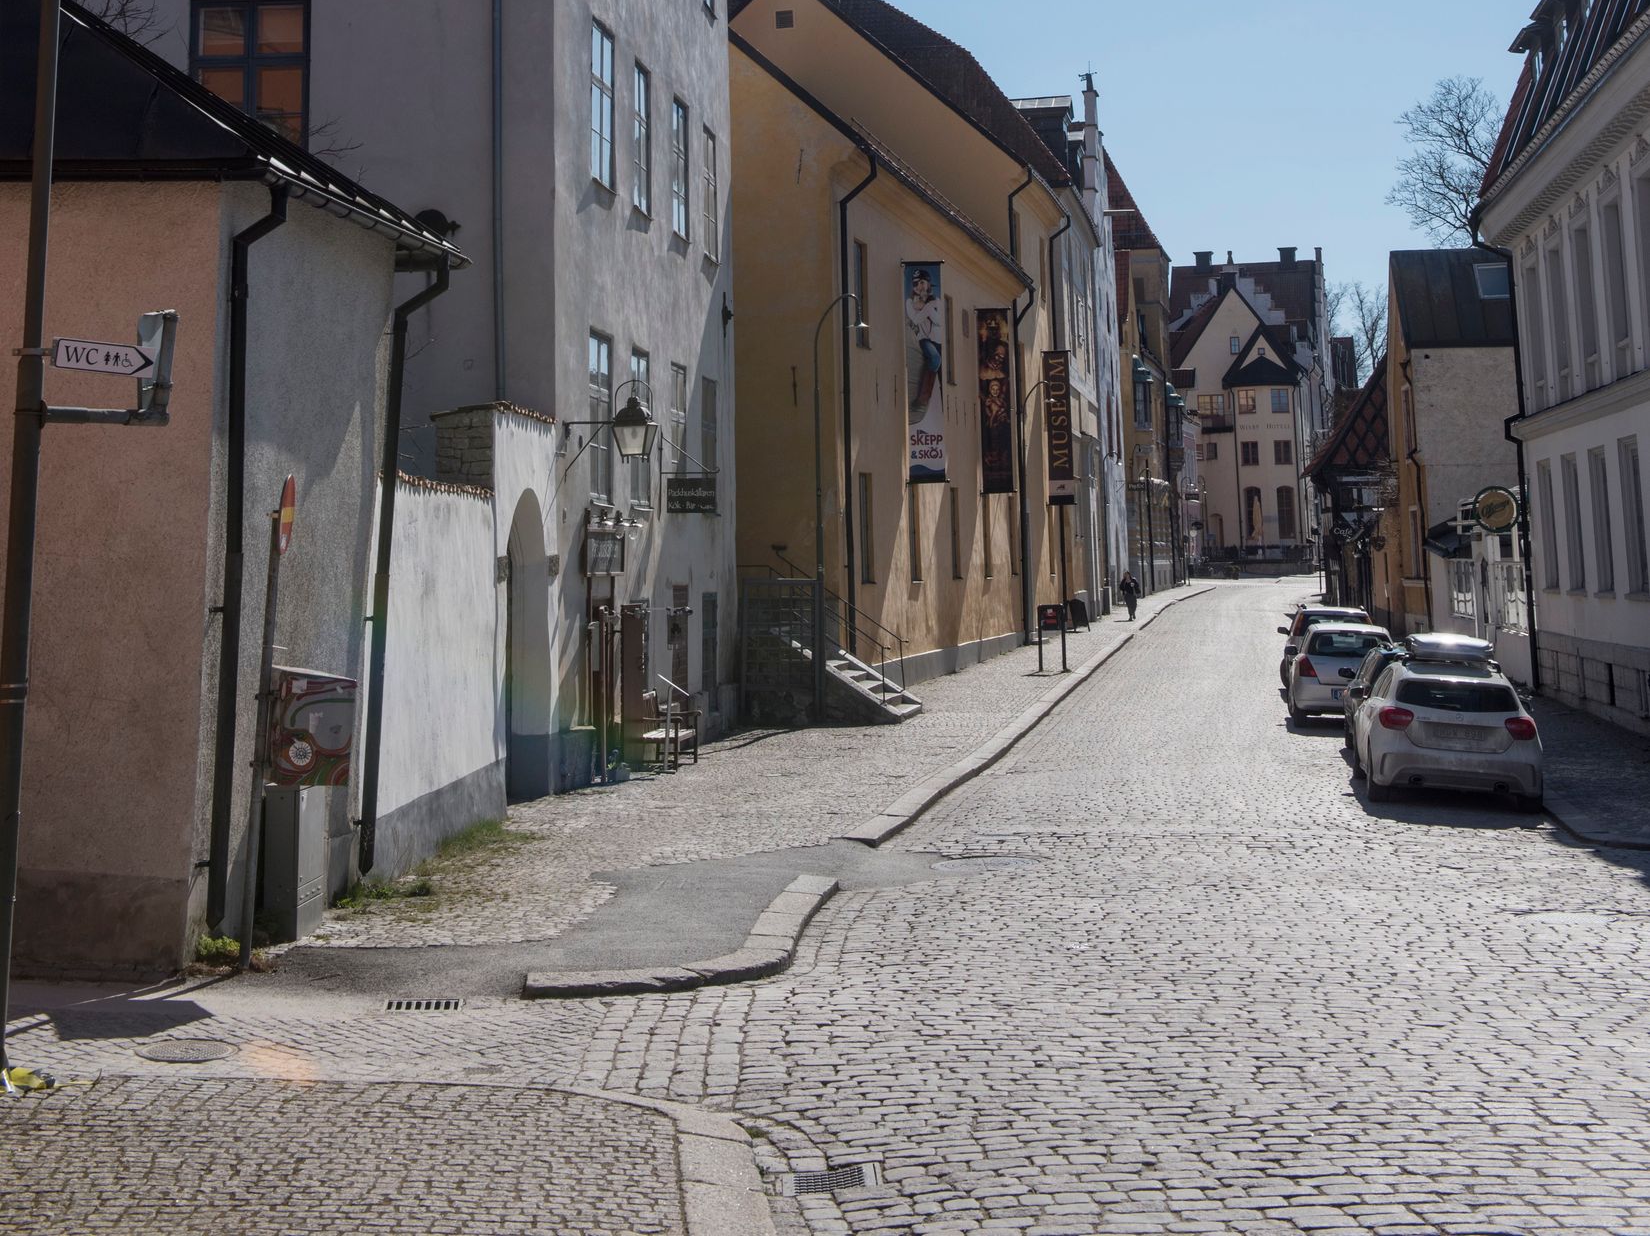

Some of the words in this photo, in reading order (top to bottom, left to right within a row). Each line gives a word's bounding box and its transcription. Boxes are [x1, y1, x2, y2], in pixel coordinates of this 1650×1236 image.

[65, 345, 99, 366] WC
[1049, 357, 1069, 468] MUSEUM
[910, 430, 943, 445] SKEPP
[911, 450, 918, 459] &
[1333, 527, 1353, 537] Café
